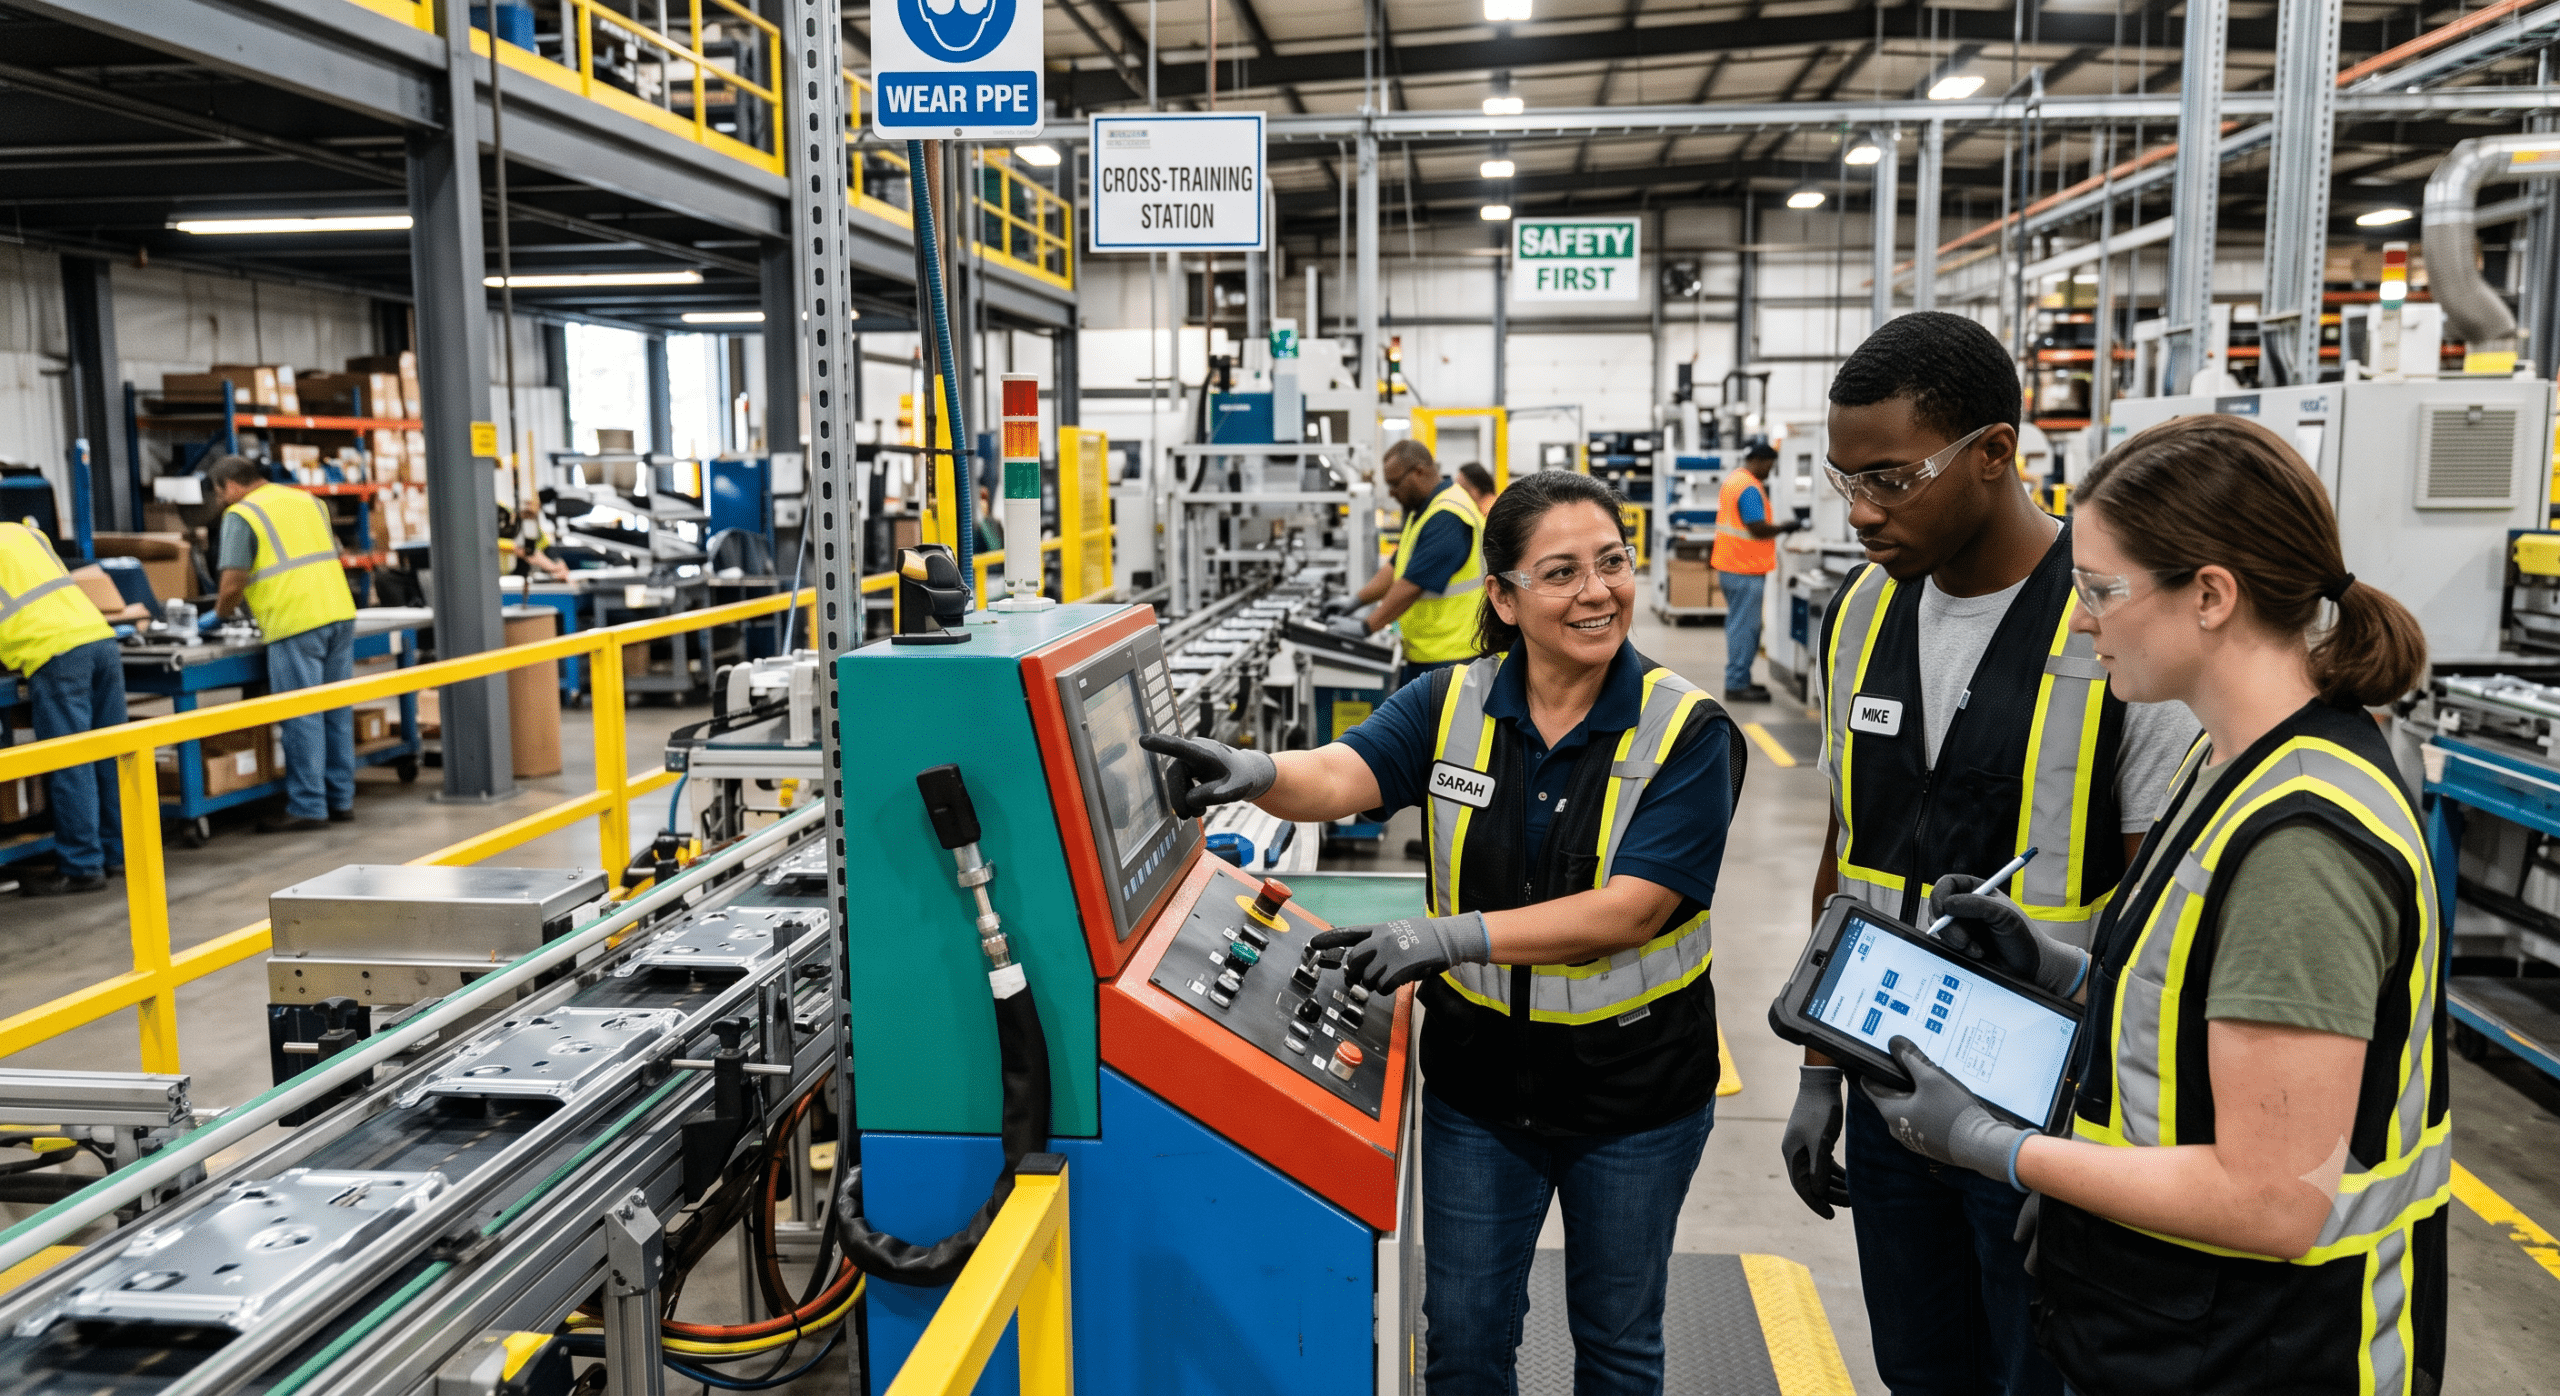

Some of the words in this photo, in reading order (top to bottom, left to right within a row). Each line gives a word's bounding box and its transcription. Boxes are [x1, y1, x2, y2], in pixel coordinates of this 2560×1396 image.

[885, 84, 968, 113] WEAR
[976, 84, 1029, 112] PPE
[1103, 166, 1253, 193] CROSS-TRAINING
[1141, 203, 1214, 229] STATION
[1522, 226, 1631, 256] SAFETY
[1537, 267, 1616, 291] FIRST
[1861, 707, 1890, 724] MIKE
[1436, 772, 1485, 797] SARAH
